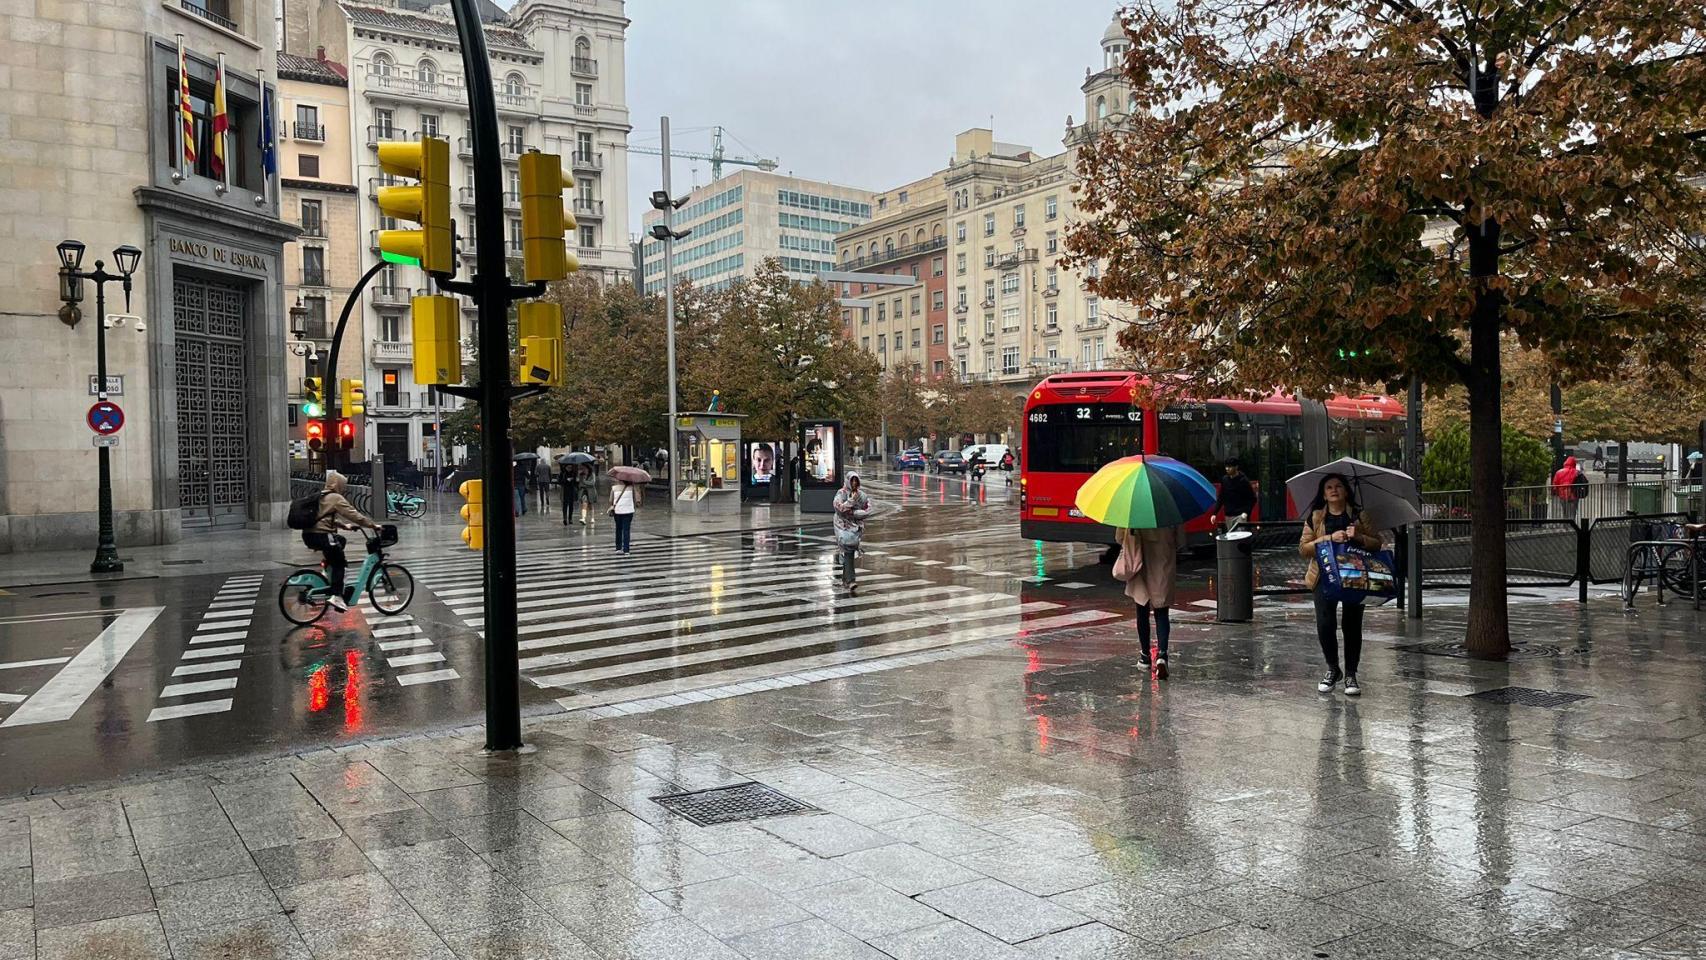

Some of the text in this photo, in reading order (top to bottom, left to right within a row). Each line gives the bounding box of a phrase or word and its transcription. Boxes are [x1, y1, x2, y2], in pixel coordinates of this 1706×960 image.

[169, 238, 268, 272] BANCO DE ESPAÑA
[1029, 413, 1048, 423] 4682
[1076, 407, 1091, 419] 32
